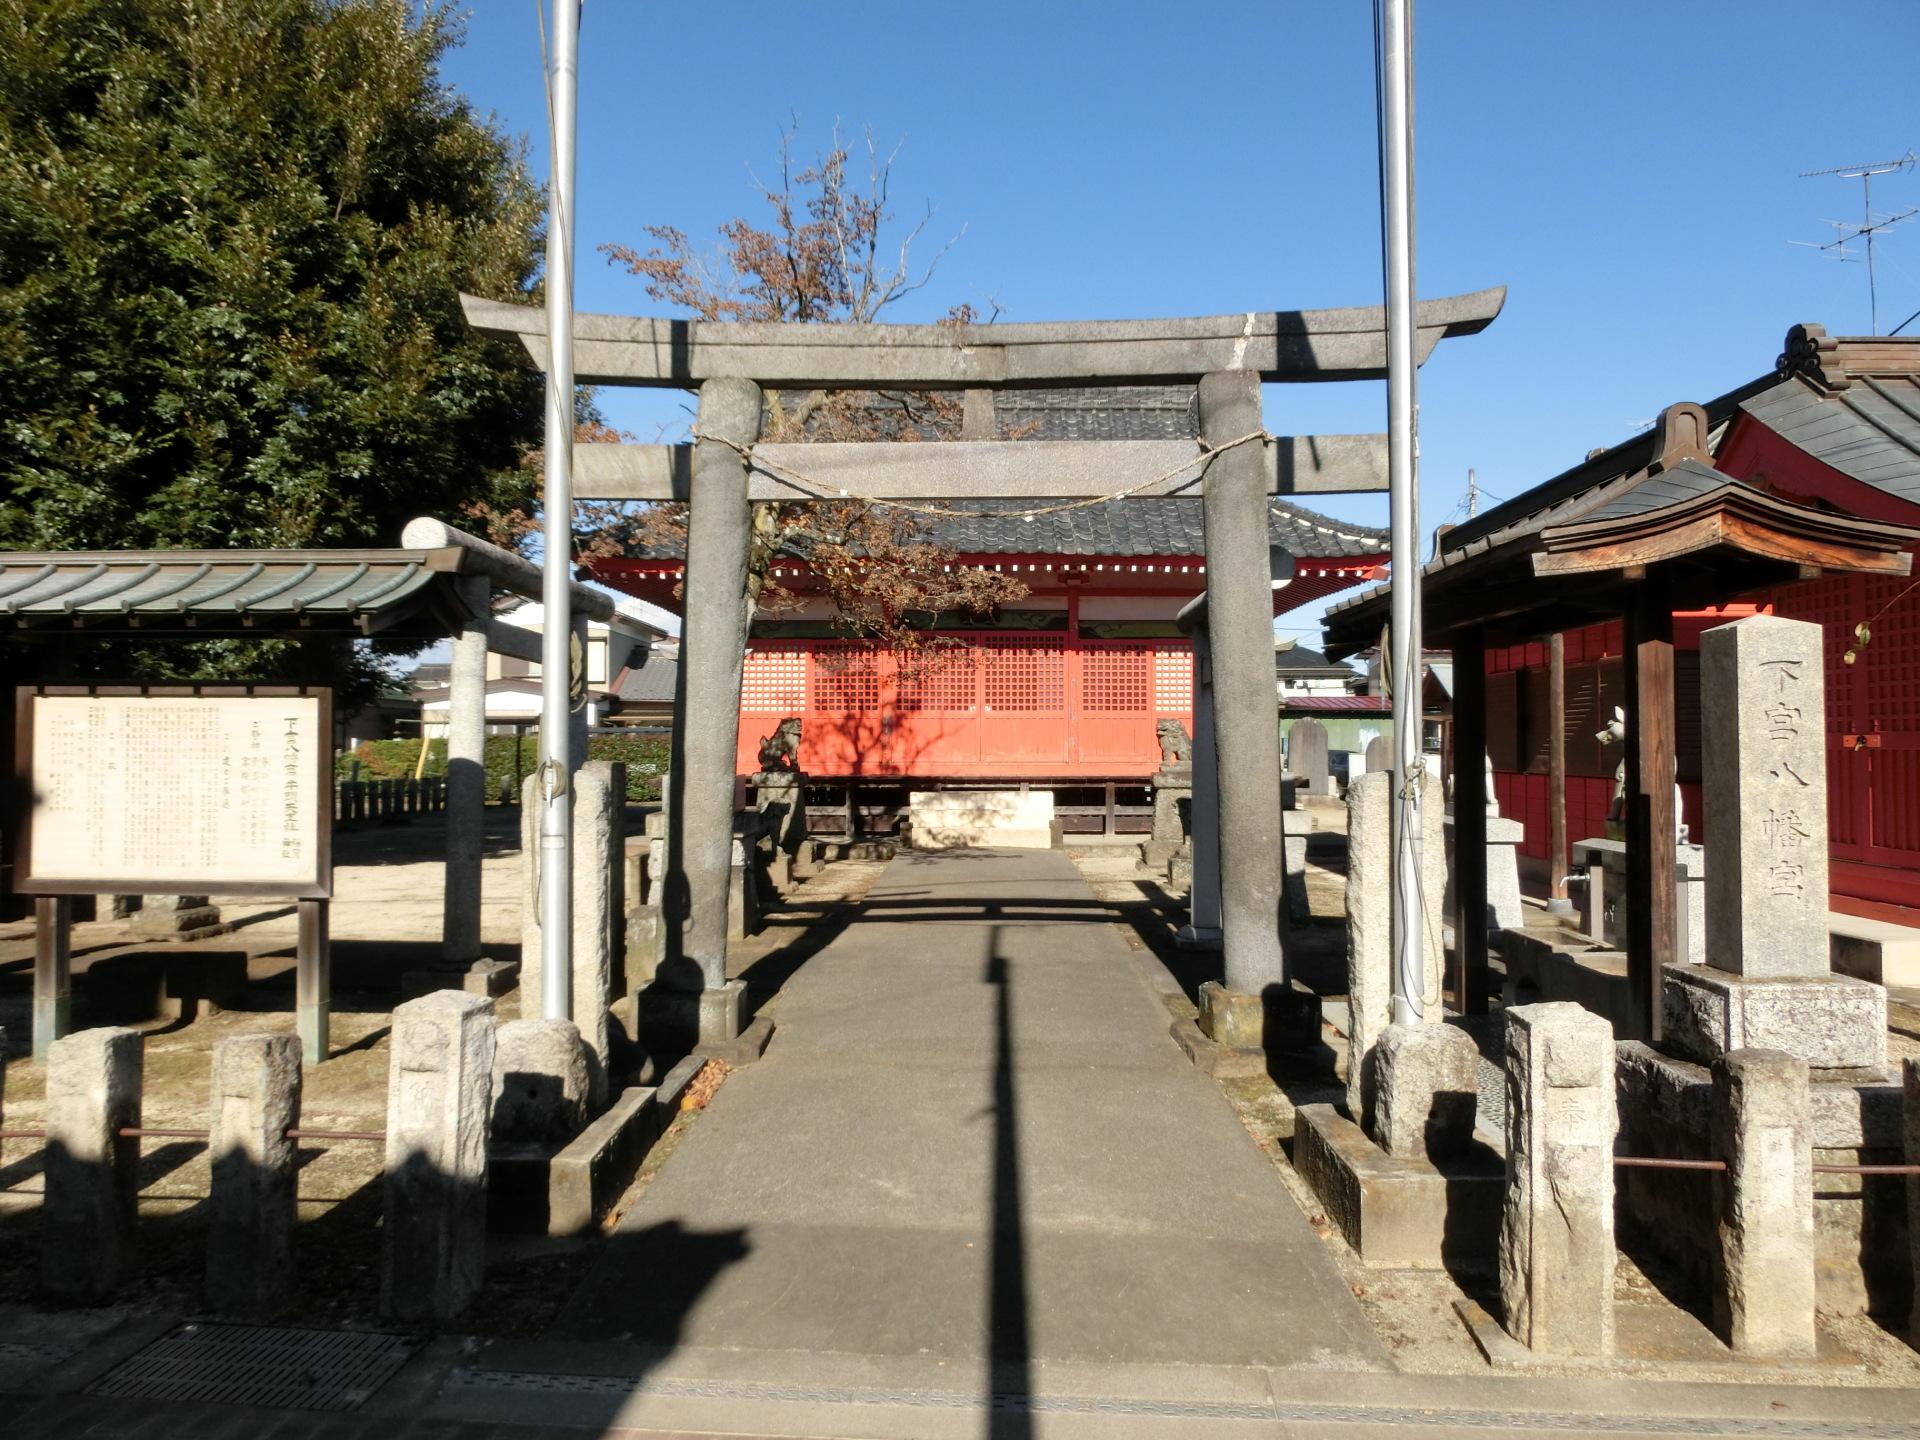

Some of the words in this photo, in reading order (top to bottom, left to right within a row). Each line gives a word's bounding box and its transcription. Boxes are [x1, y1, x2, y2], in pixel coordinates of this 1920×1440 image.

[1759, 660, 1811, 900] 下宮八幡宮
